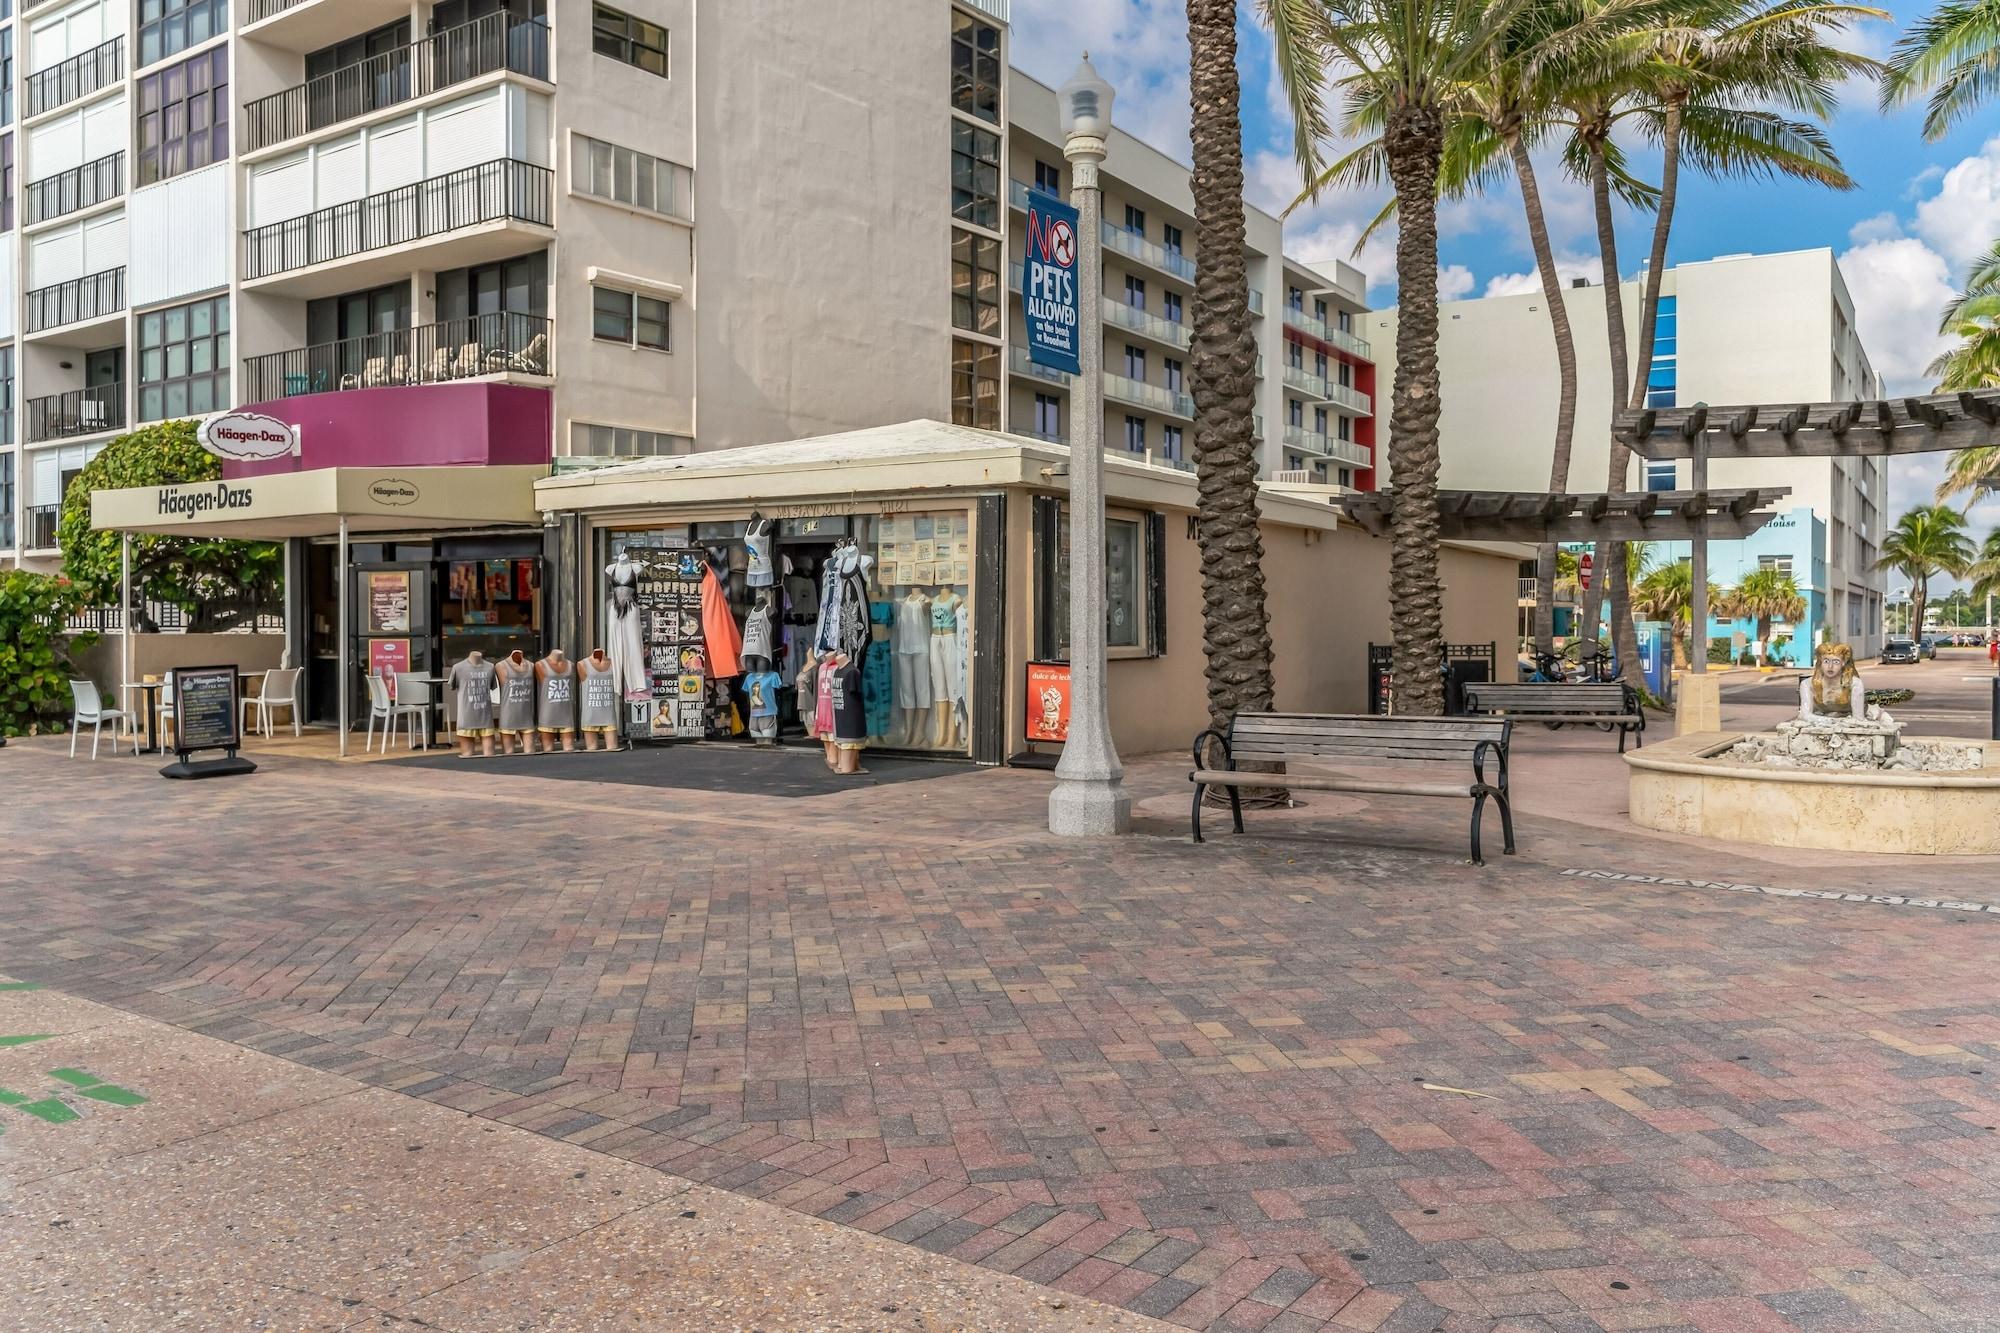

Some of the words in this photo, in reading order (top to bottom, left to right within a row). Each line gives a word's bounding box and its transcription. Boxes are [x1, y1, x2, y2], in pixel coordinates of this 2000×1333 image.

[1027, 208, 1076, 268] NO
[1031, 261, 1073, 306] PETS
[1028, 296, 1076, 327] ALLOWED
[1036, 322, 1043, 331] on
[1044, 320, 1054, 334] the
[1055, 323, 1070, 338] beach
[1036, 333, 1042, 342] or
[663, 646, 678, 656] NOT
[1032, 672, 1049, 680] dulce
[548, 679, 570, 690] SIX
[548, 689, 570, 699] PACK
[652, 686, 679, 694] MOMS
